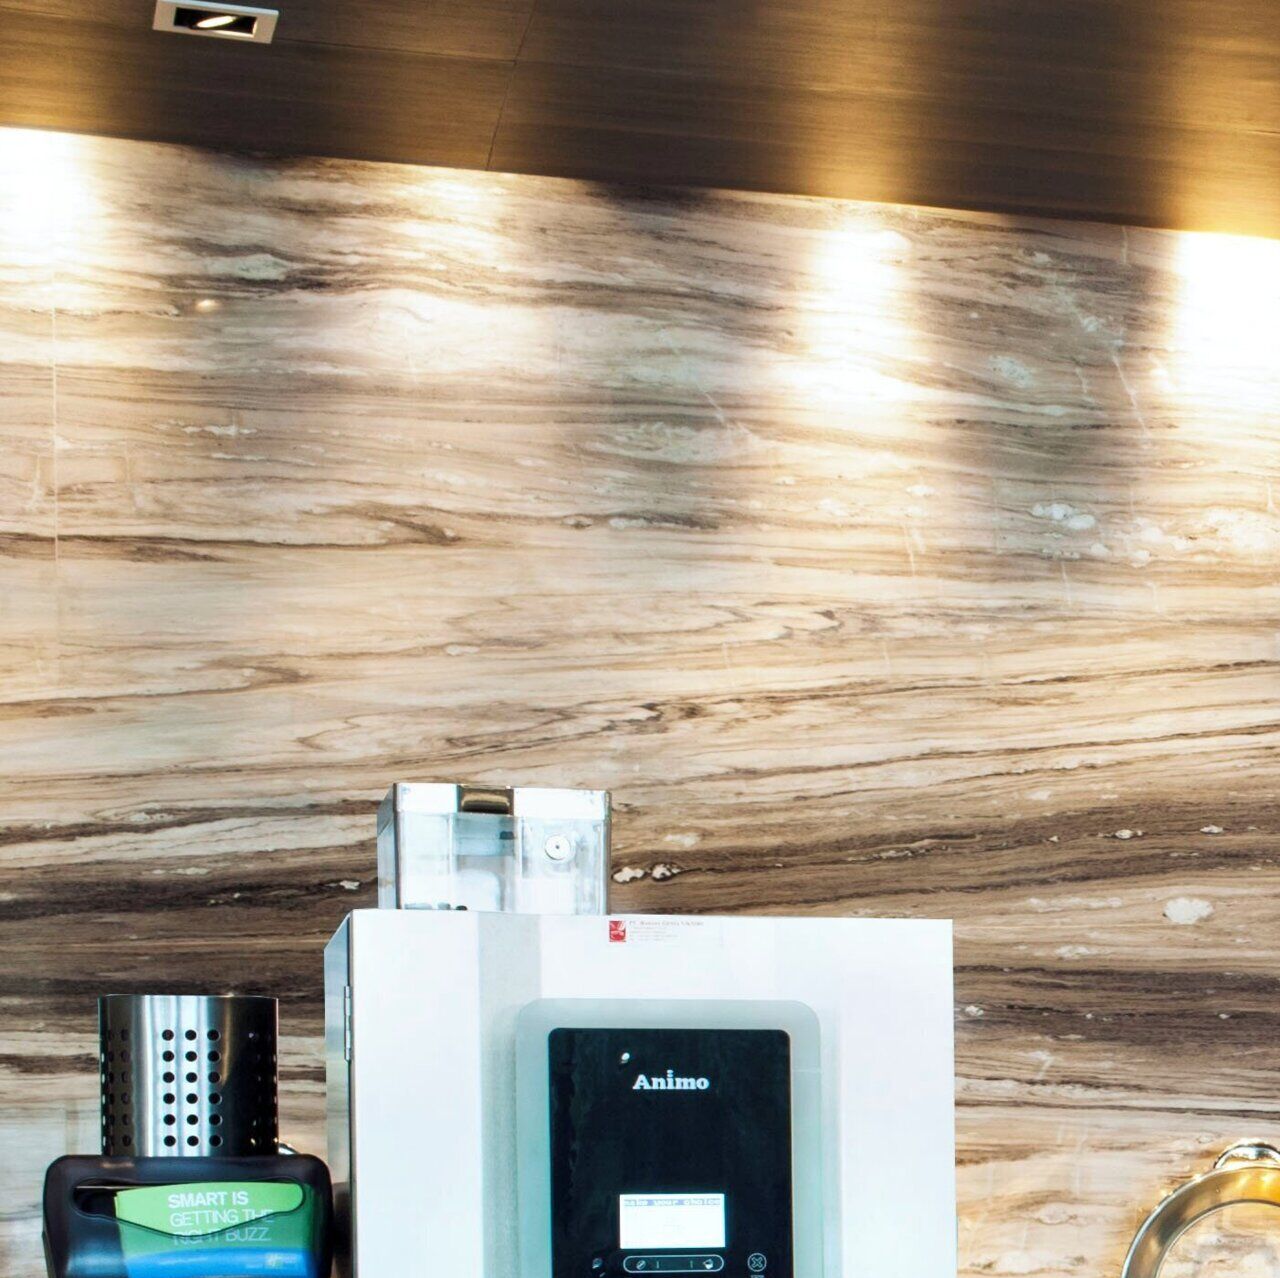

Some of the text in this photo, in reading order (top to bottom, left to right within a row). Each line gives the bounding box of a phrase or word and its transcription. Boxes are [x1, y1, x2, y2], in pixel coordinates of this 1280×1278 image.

[632, 1069, 710, 1090] Animo
[168, 1191, 249, 1209] SMART IS
[170, 1208, 275, 1228] GETTING THE
[226, 1226, 273, 1242] BUZZ
